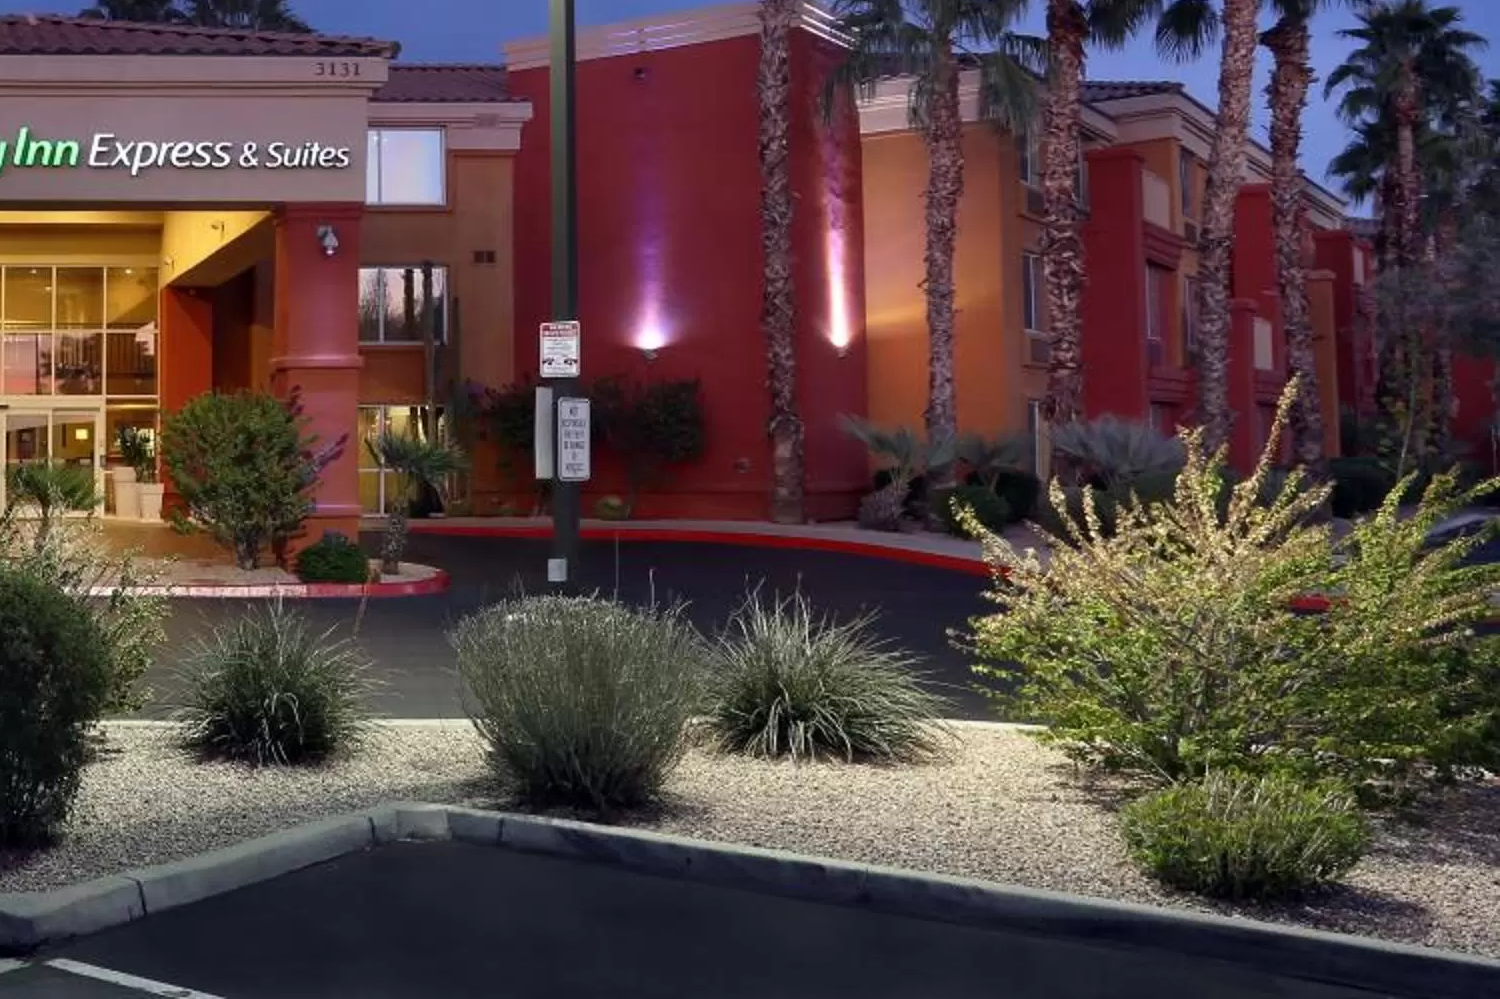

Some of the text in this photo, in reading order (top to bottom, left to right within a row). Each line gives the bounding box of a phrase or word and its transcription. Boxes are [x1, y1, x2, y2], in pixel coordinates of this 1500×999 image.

[313, 61, 361, 78] 3131
[13, 126, 80, 166] Inn
[88, 132, 232, 176] Express
[238, 141, 259, 168] &
[264, 141, 351, 168] Suites
